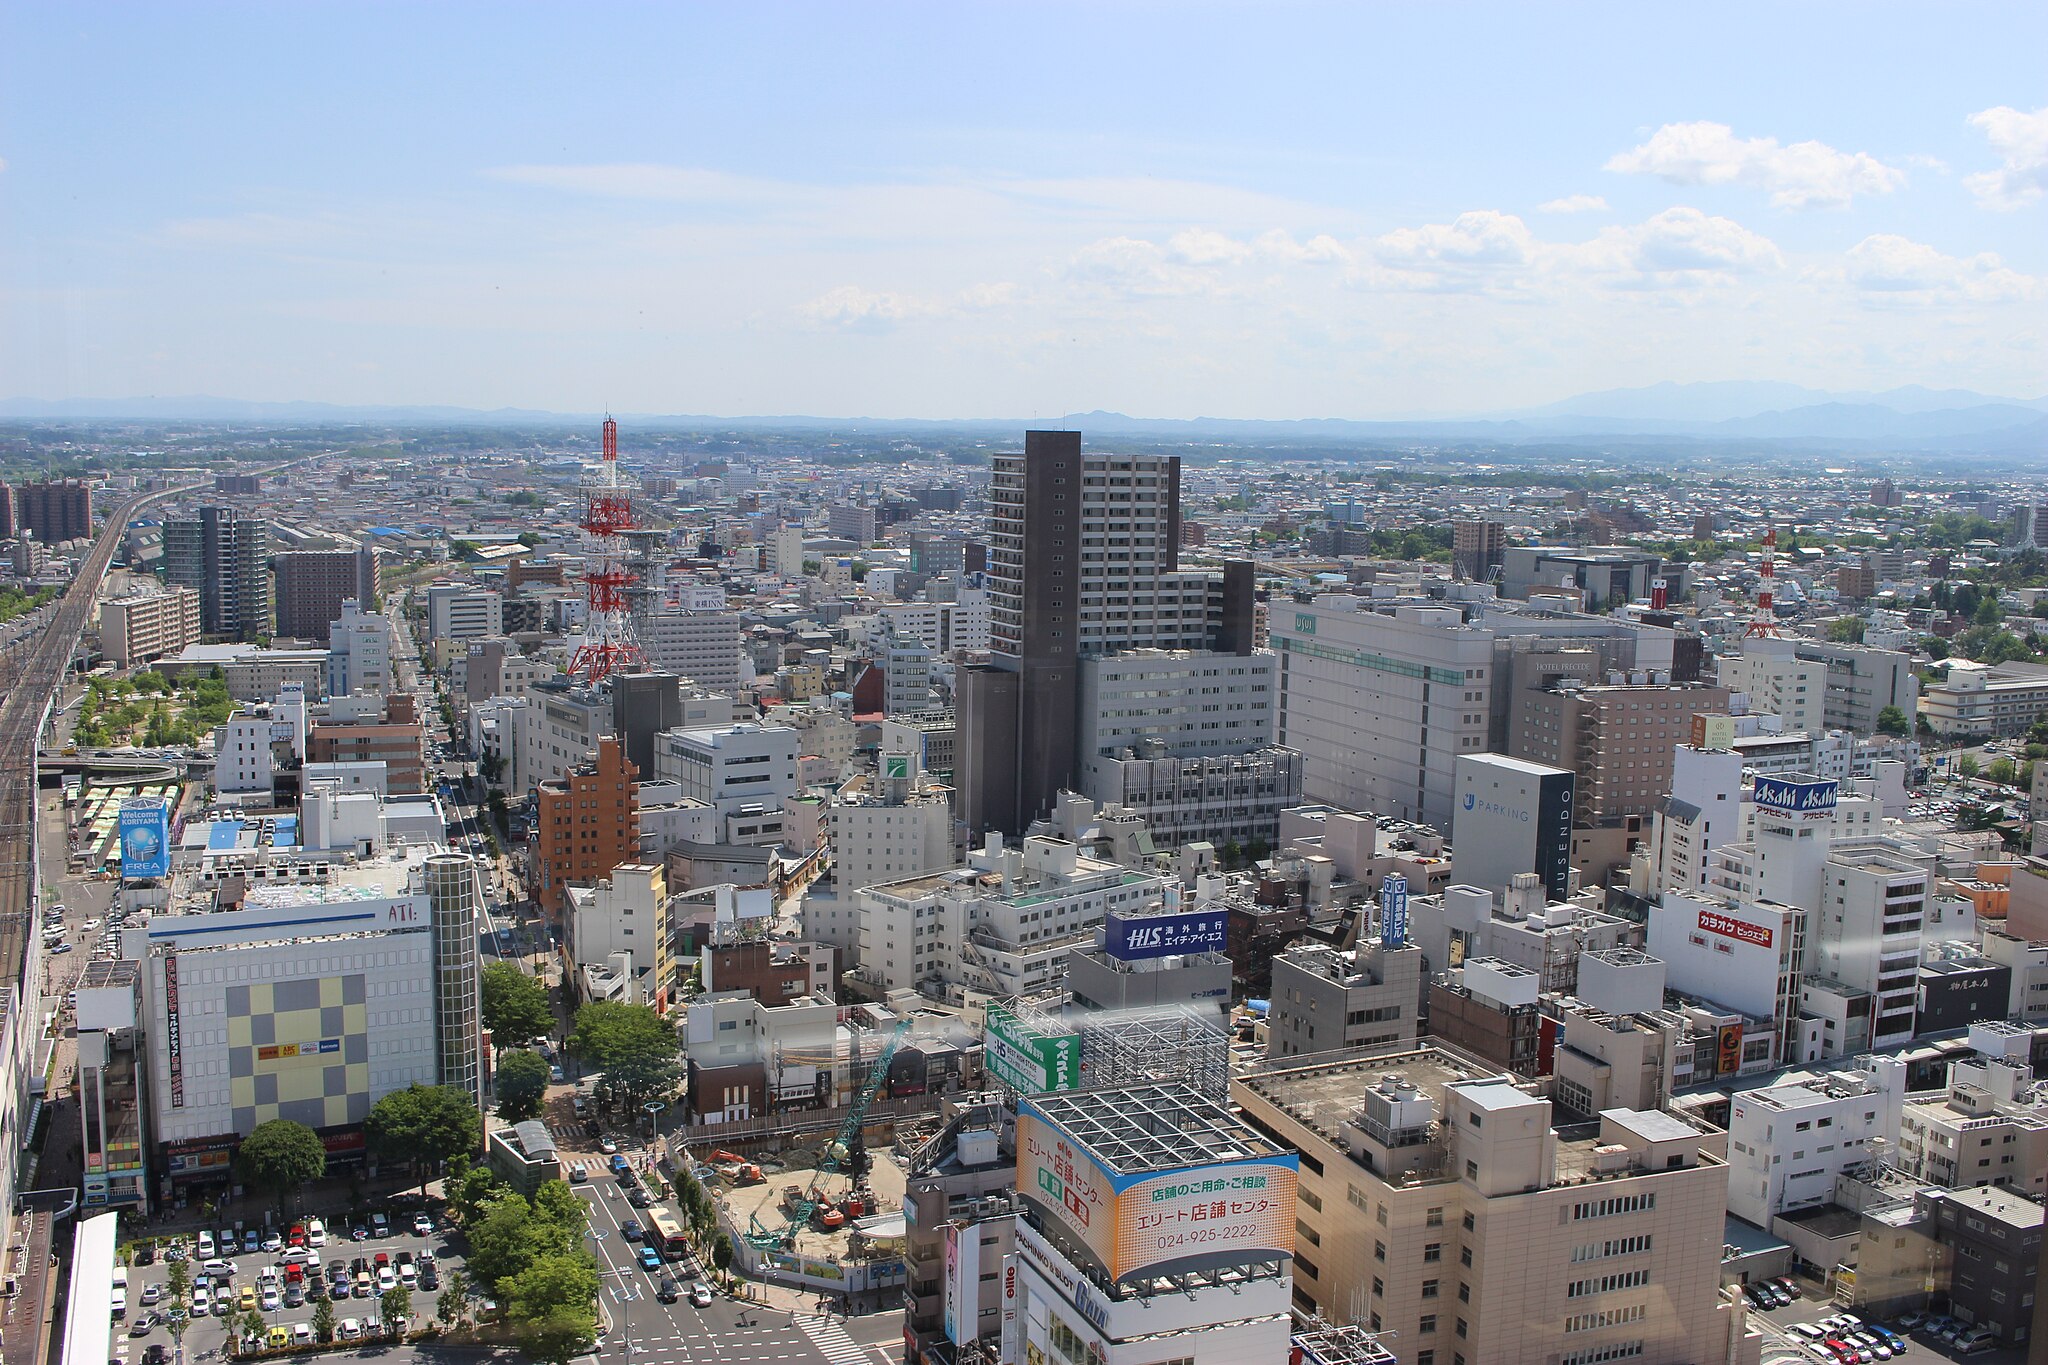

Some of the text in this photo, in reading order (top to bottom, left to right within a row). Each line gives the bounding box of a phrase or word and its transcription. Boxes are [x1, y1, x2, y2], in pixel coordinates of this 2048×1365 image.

[1755, 782, 1797, 808] Asahi
[1801, 786, 1837, 809] Asahi
[121, 811, 159, 819] Welcome
[121, 818, 160, 826] KORIYAMA
[1478, 799, 1529, 822] PARKING
[1756, 805, 1793, 820] アサヒビール
[1802, 811, 1834, 821] アサヒビール
[1556, 790, 1571, 894] JUSENDO
[125, 862, 160, 870] FREA
[1700, 915, 1735, 933] カラオケ
[166, 959, 177, 1012] ヨドバシカメラ
[1027, 1136, 1104, 1207] エリート店舗センター
[1151, 1175, 1268, 1203] 店舗のご用命・ご相談
[1137, 1199, 1279, 1231] エリート店舗センター
[1157, 1224, 1258, 1250] 024-925-2222
[1015, 1229, 1049, 1268] PACHINKO
[1054, 1269, 1074, 1292] SLOT
[1005, 1266, 1015, 1299] elite
